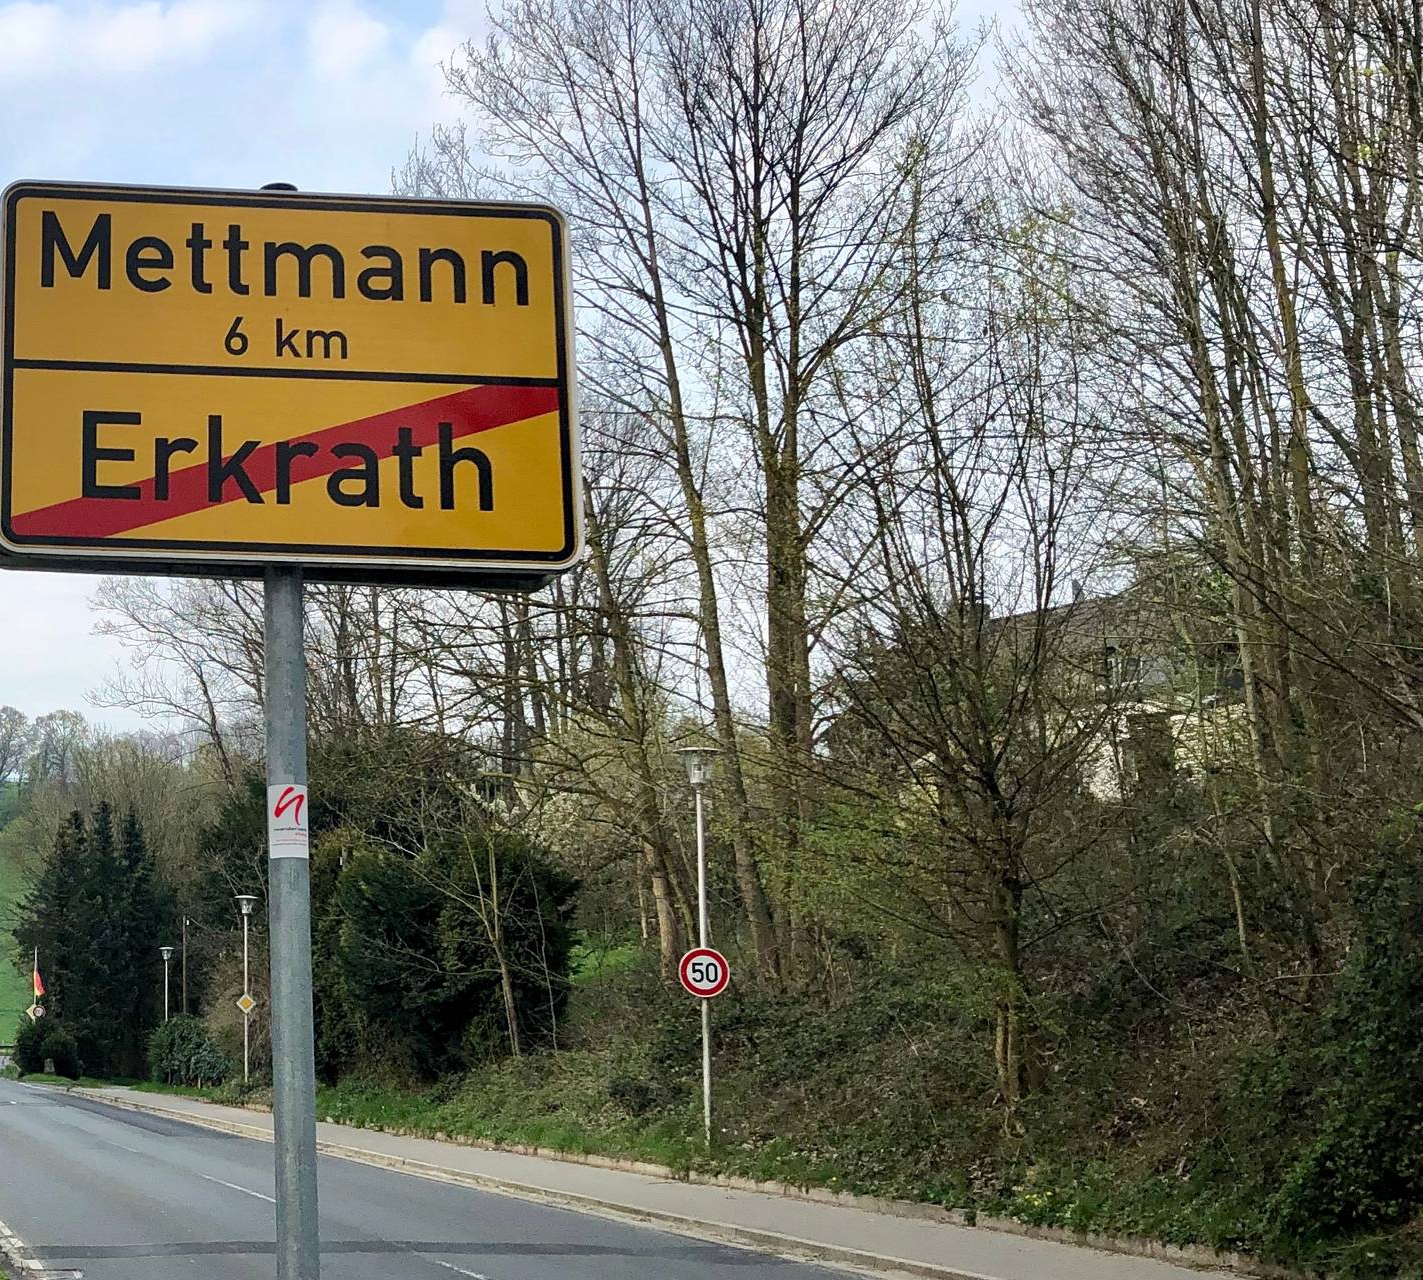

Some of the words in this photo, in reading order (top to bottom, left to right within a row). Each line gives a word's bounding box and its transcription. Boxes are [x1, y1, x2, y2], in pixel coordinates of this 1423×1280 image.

[40, 210, 530, 307] Mettmann
[224, 316, 249, 356] 6
[275, 318, 348, 360] km
[81, 410, 494, 512] Erkrath
[691, 962, 719, 983] 50
